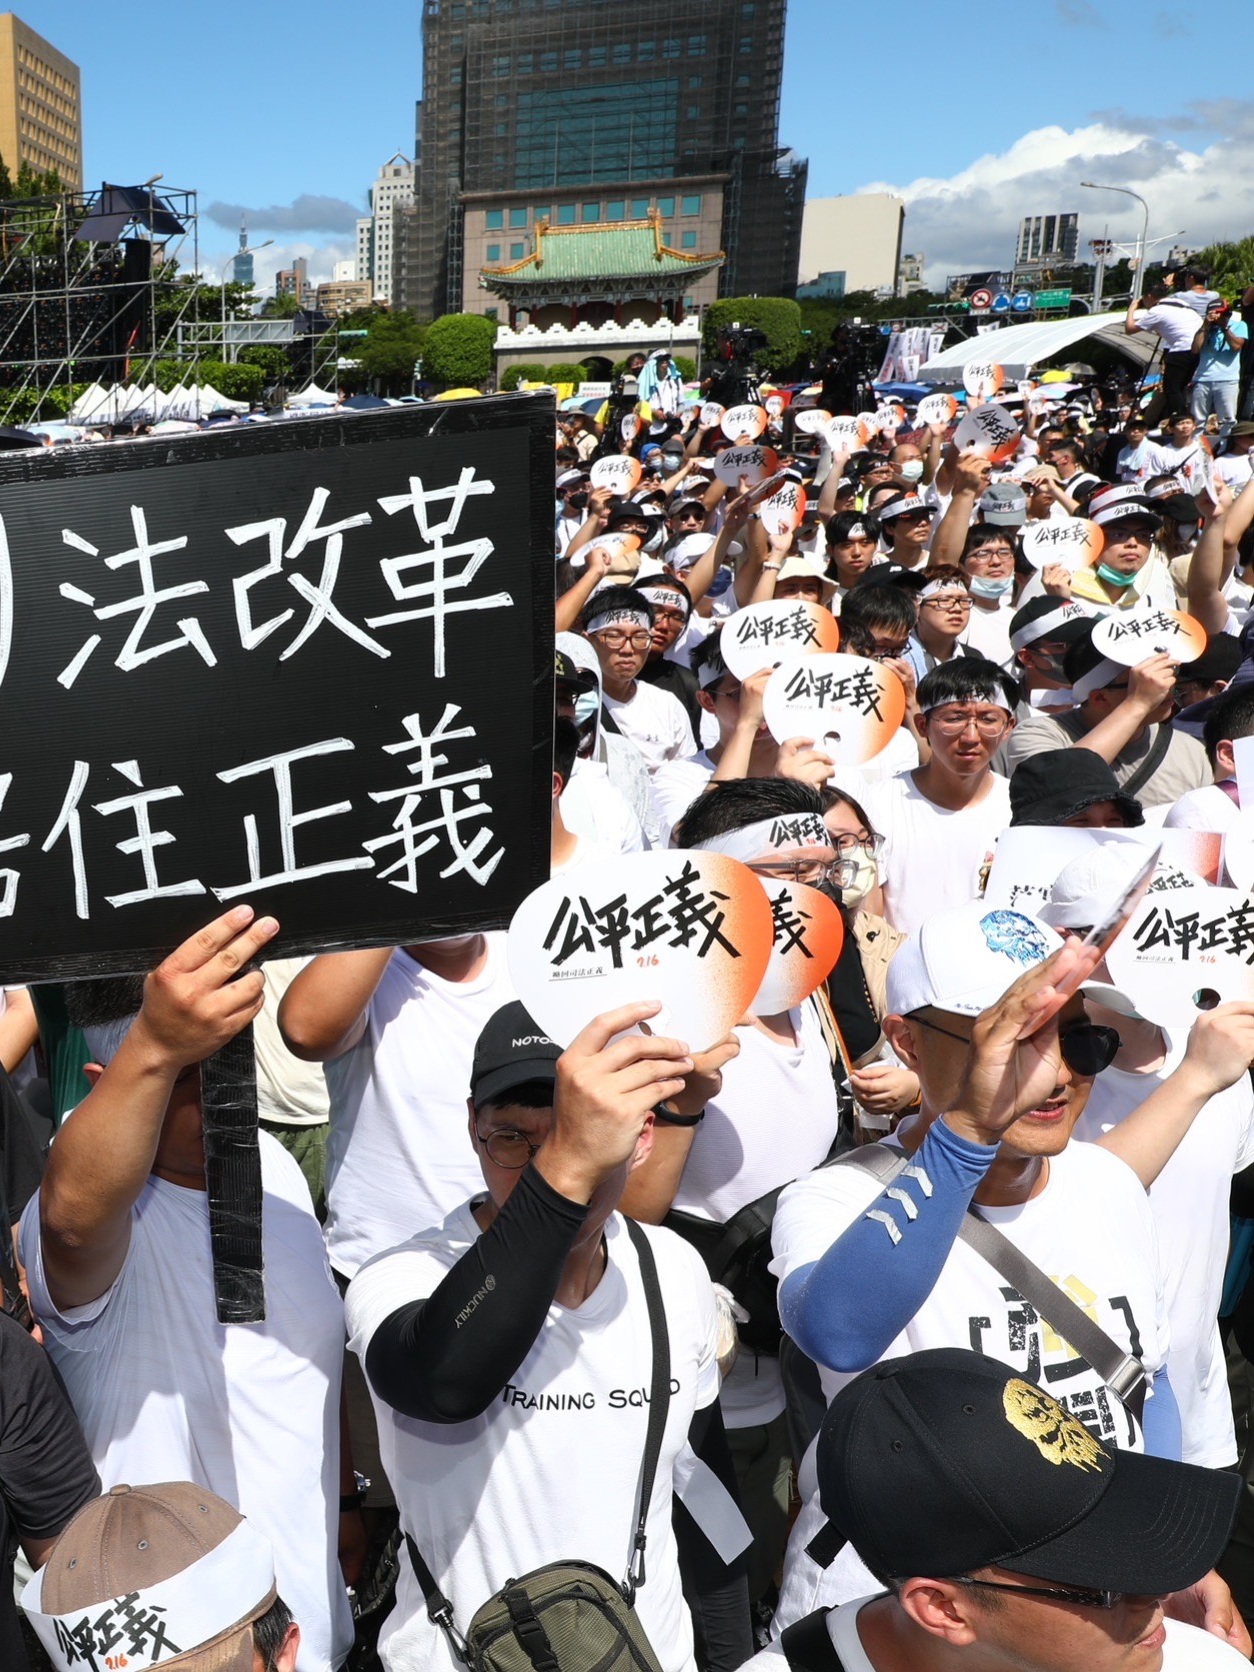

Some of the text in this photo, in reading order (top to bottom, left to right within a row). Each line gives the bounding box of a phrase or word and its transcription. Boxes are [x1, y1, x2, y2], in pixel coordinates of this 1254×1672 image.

[598, 459, 634, 478] 公平正義
[722, 448, 768, 467] 公平正義
[1035, 522, 1092, 547] 公平正義
[737, 605, 822, 648] 公平正義
[1107, 610, 1192, 640] 公平正義
[784, 665, 885, 722] 公平正義
[769, 812, 830, 848] 公平正義
[543, 860, 743, 969] 公平正義
[1132, 898, 1254, 966] 公平正義
[512, 1035, 552, 1049] NOTO
[502, 1383, 596, 1411] TRAINING
[52, 1591, 183, 1672] 公平正義
[105, 1653, 129, 1671] 7.16
